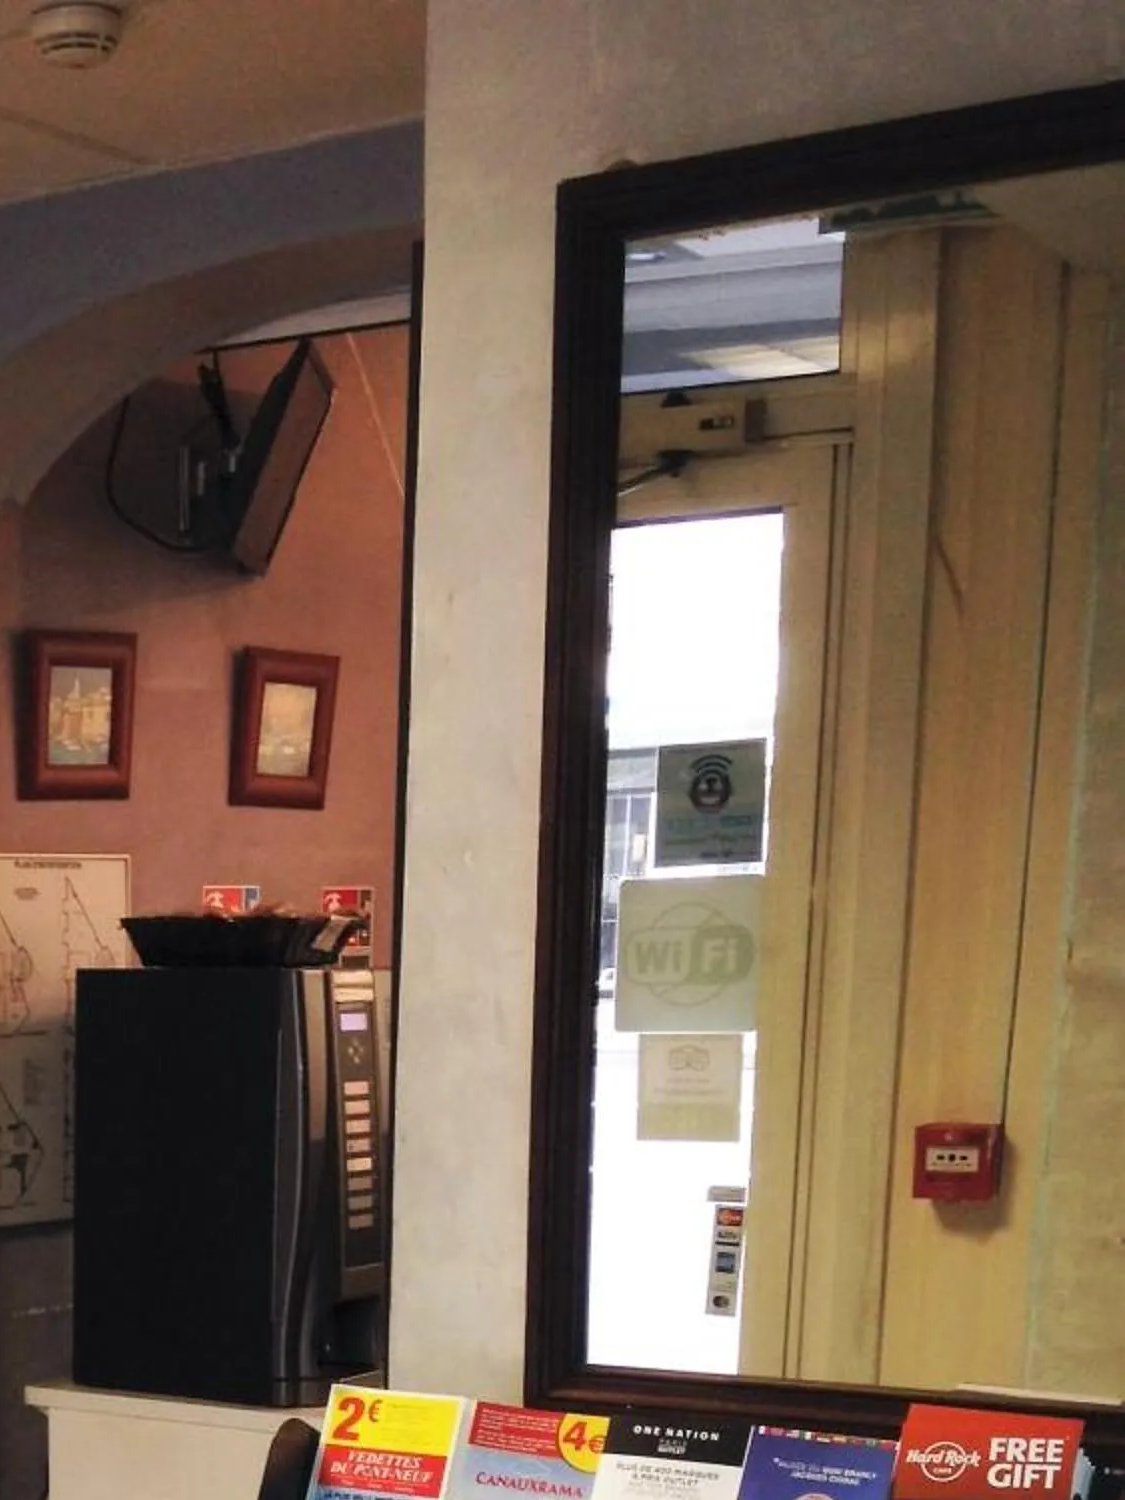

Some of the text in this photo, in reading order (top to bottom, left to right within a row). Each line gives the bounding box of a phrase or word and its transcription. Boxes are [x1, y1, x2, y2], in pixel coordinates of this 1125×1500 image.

[332, 1397, 383, 1441] 2€
[563, 1421, 605, 1452] 4€
[633, 1425, 720, 1441] ONE NATION
[348, 1451, 423, 1469] VEDETTES
[988, 1437, 1064, 1462] FREE
[331, 1461, 434, 1483] DU PONT-NEUF
[475, 1470, 584, 1499] CANAUXRAMA
[986, 1463, 1061, 1489] GIFT
